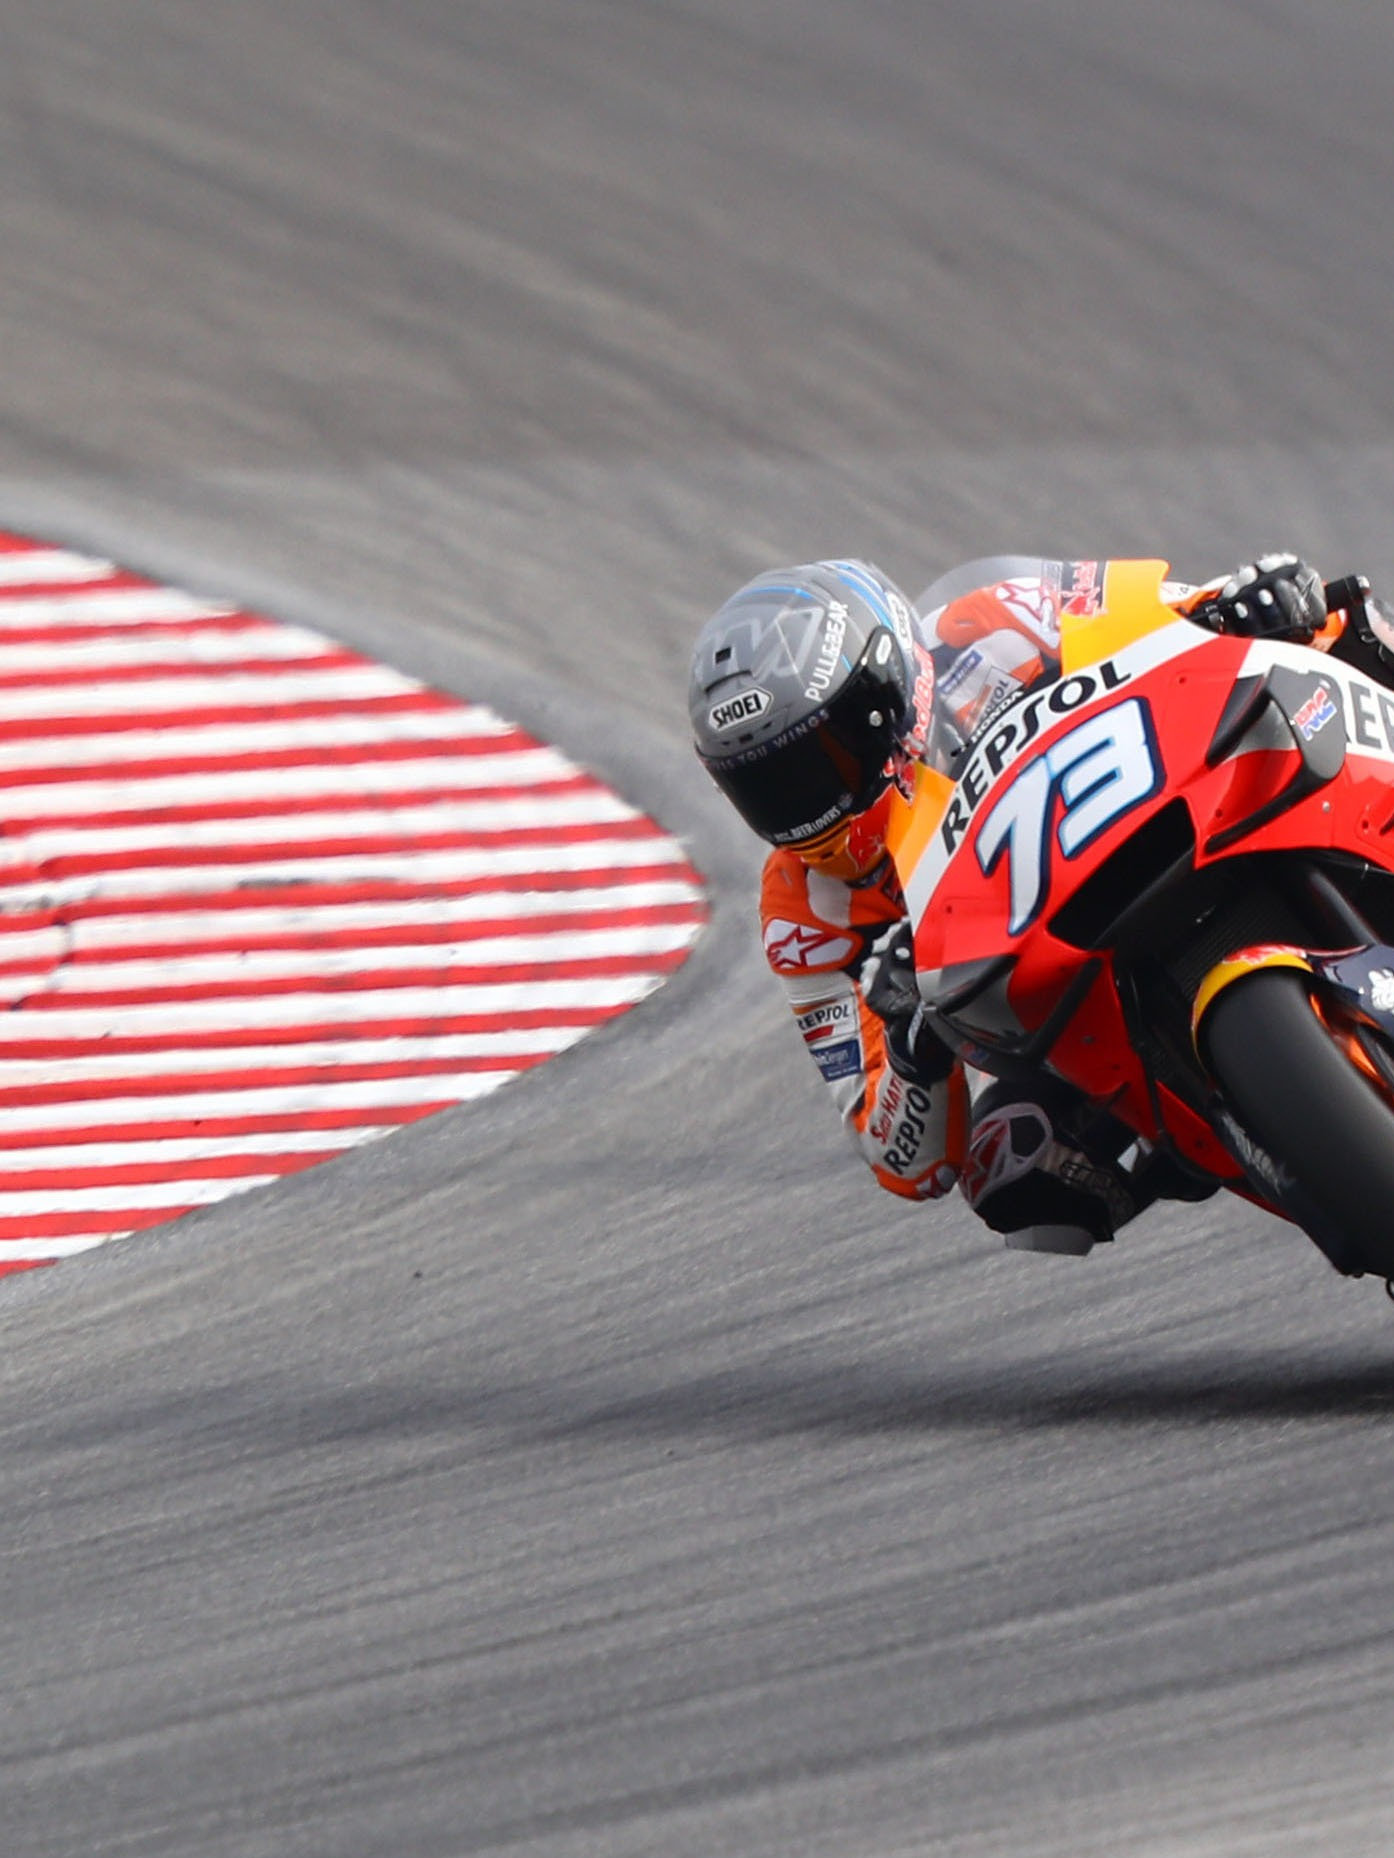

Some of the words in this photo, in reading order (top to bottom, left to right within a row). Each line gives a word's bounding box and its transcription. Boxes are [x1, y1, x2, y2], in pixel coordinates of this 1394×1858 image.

[804, 600, 848, 702] PULL&BEAR
[712, 693, 761, 728] SHOEI
[941, 661, 1131, 857] REPSOL
[976, 696, 1166, 936] 73
[884, 1084, 932, 1176] REPSO
